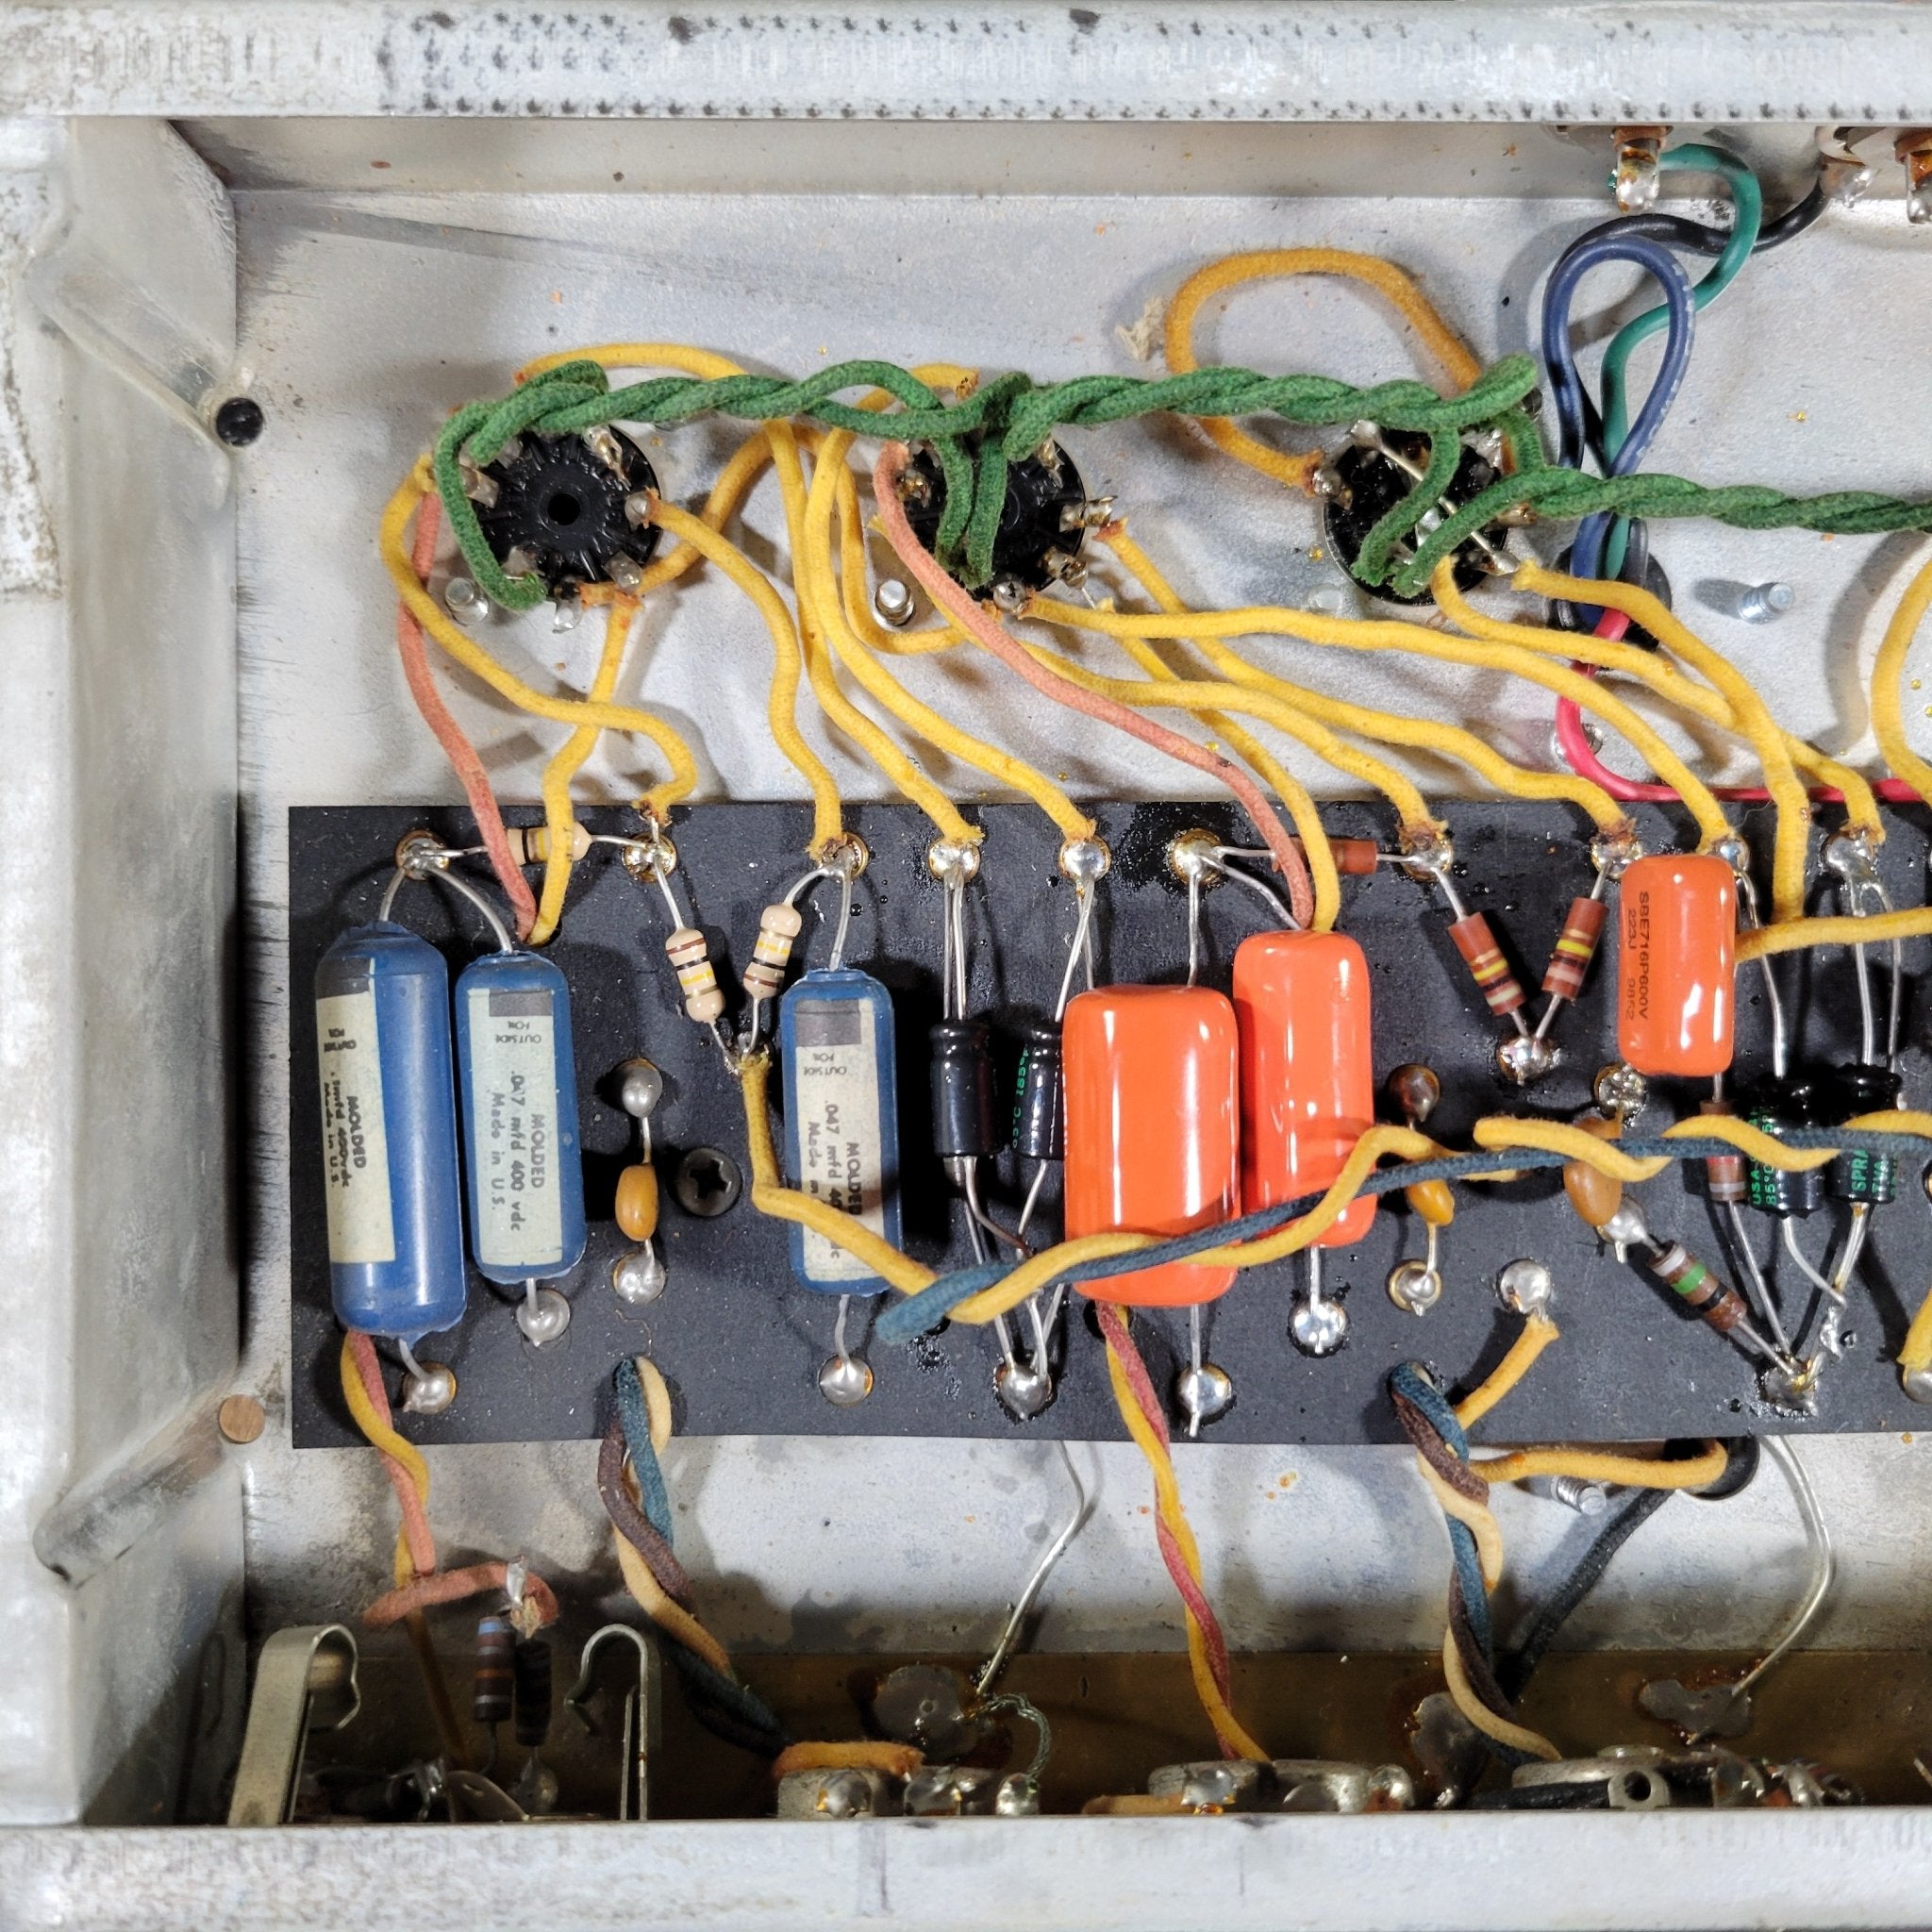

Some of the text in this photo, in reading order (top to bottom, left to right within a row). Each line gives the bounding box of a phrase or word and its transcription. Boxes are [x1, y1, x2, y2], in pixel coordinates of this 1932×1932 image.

[1627, 908, 1638, 951] 223J
[1639, 890, 1651, 1021] SBE716P600V
[345, 1095, 368, 1170] MOLDED
[510, 1117, 527, 1151] mfd
[824, 1099, 841, 1135] .047
[491, 1091, 506, 1211] Made in U.S.
[530, 1113, 546, 1189] MOLDED
[826, 1144, 843, 1179] mfd
[511, 1159, 526, 1192] 400
[845, 1141, 862, 1216] MOLDED
[510, 1201, 527, 1232] vdc
